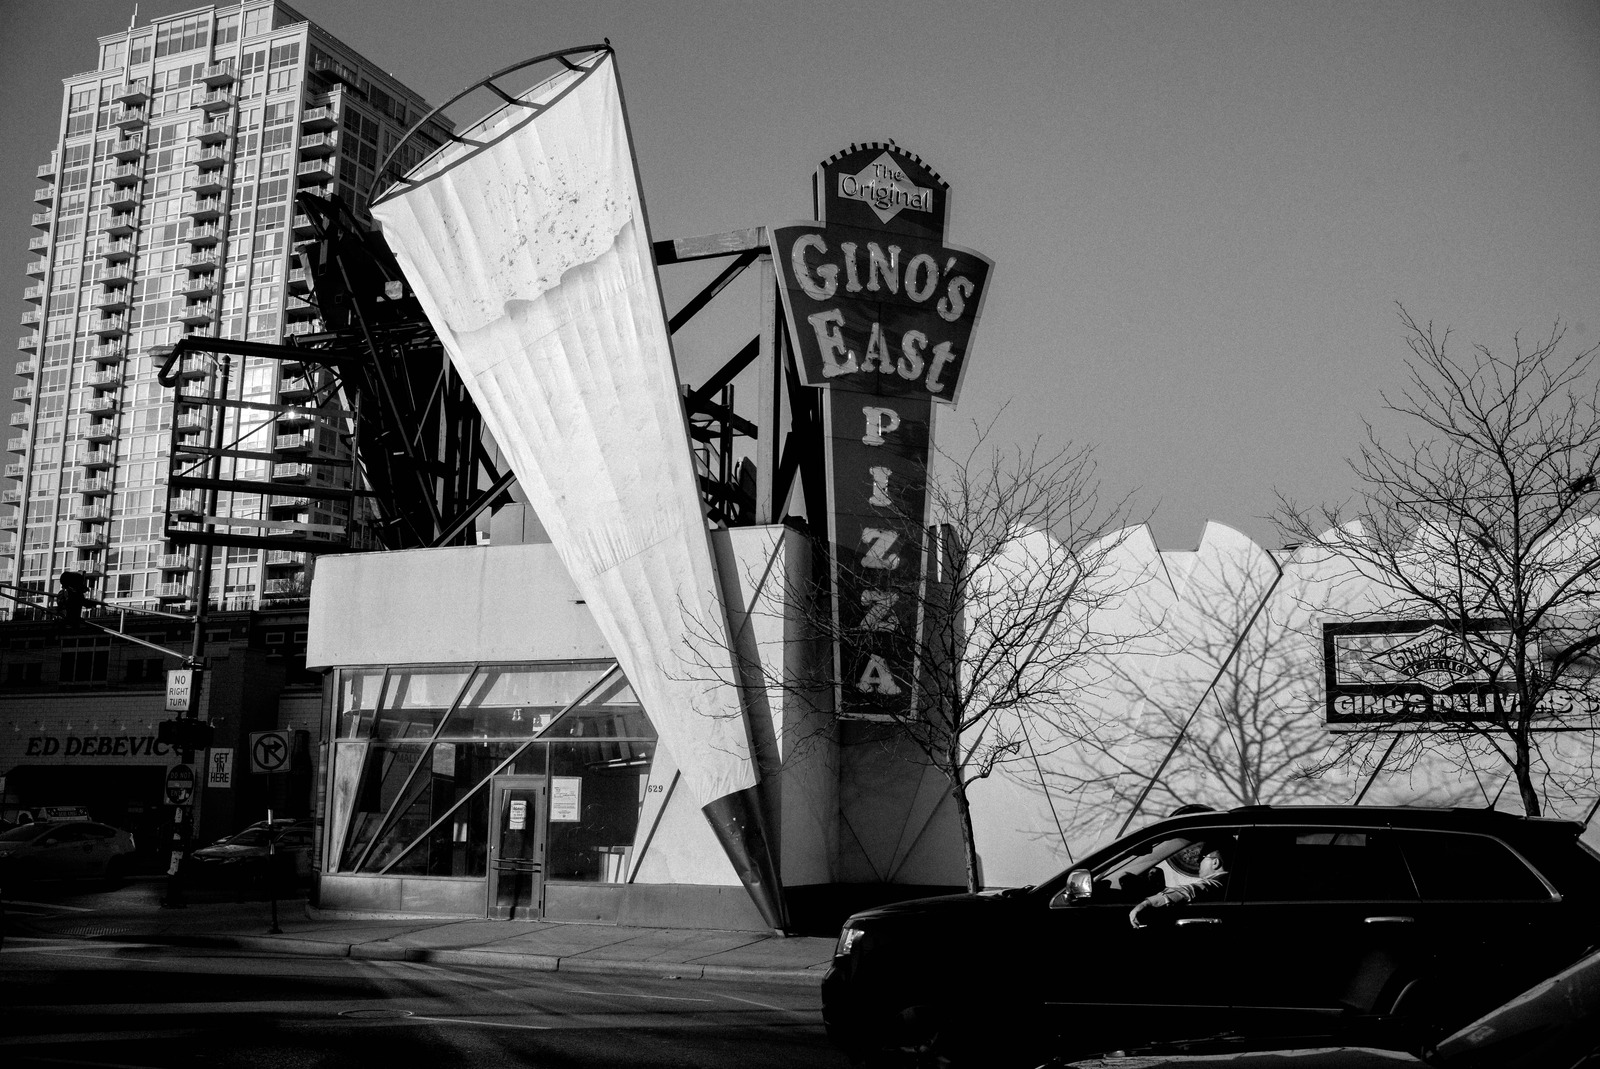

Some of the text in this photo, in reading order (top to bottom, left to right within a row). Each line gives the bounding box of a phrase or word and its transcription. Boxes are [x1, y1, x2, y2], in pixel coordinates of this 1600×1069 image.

[873, 163, 904, 182] The
[841, 175, 930, 213] Original
[791, 233, 975, 322] GINO'S
[856, 406, 902, 695] PIZZA
[174, 675, 186, 685] NO
[169, 687, 189, 696] RIGHT
[169, 698, 188, 707] TURN
[1334, 693, 1427, 714] GINO'S
[25, 736, 184, 756] ED DEBEVIC
[214, 753, 229, 763] GET
[217, 763, 225, 772] IN
[210, 773, 229, 783] HERE
[648, 784, 664, 793] 629
